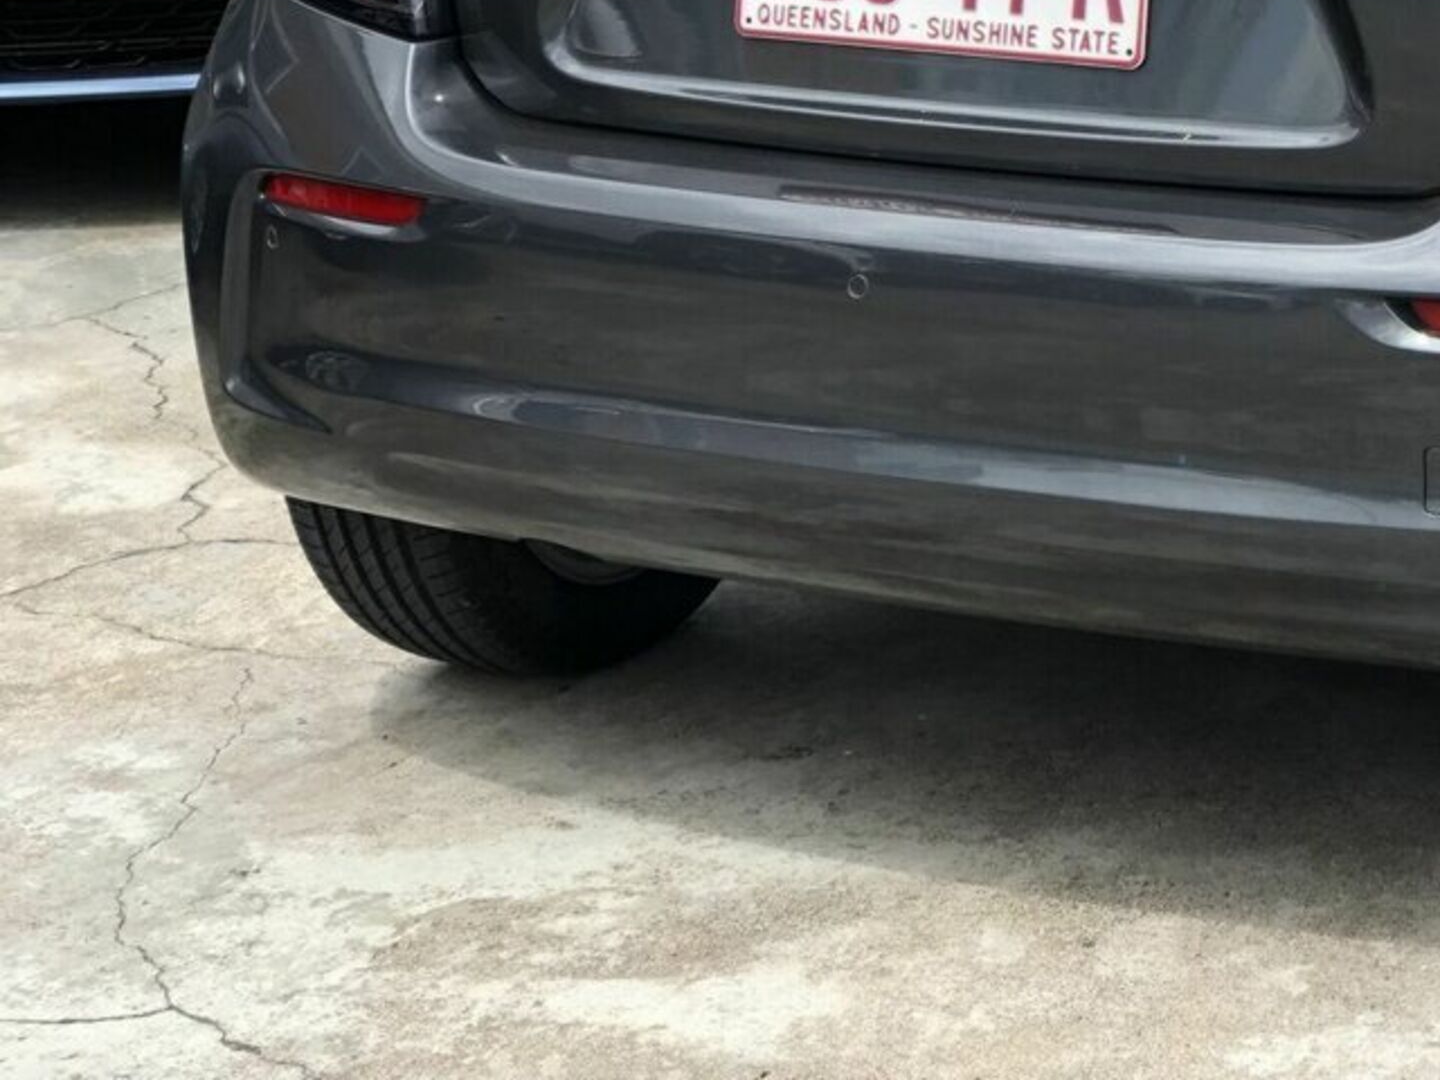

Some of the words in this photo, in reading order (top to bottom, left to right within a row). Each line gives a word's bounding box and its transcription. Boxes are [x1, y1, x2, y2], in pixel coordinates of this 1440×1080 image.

[756, 3, 901, 36] QUEENSLAND
[926, 16, 1040, 49] SUNSHINE
[1051, 26, 1120, 56] STATE
